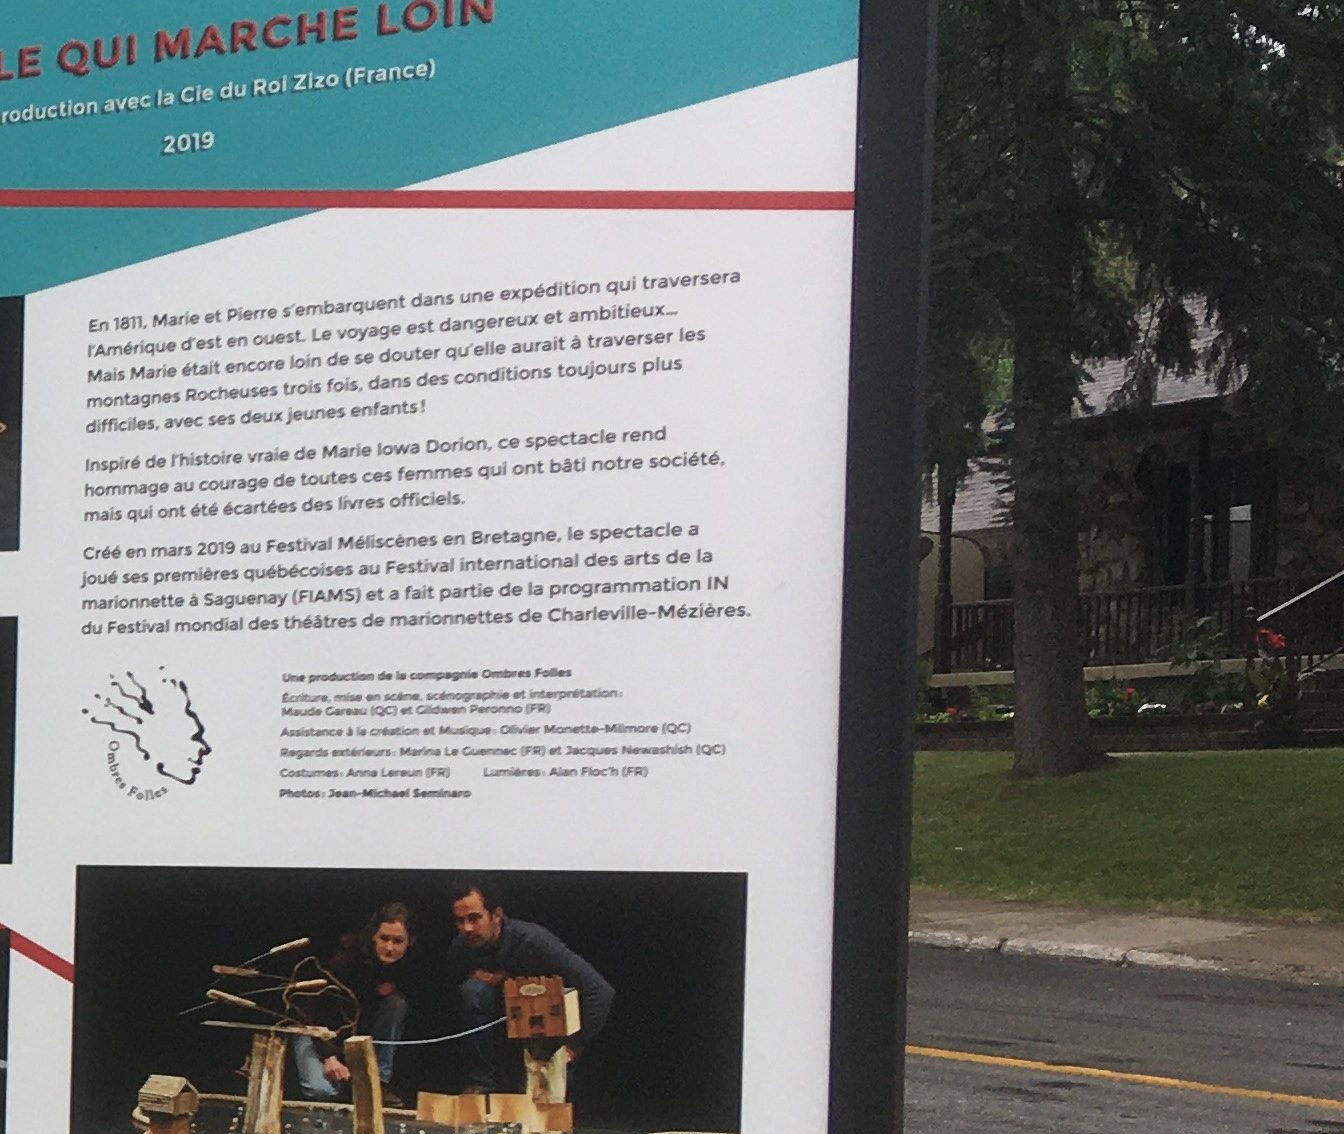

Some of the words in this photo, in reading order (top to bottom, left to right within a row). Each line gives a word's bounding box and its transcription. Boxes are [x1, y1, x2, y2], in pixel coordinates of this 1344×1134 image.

[58, 36, 138, 76] QUI
[156, 6, 358, 60] MARCHE
[379, 0, 494, 34] LOIN
[103, 94, 152, 112] avec
[157, 88, 175, 106] la
[180, 84, 215, 103] Cie
[220, 80, 248, 99] du
[253, 74, 288, 96] Roi
[293, 71, 340, 91] Zizo
[345, 58, 436, 88] (France)
[163, 130, 216, 154] 2019
[88, 318, 110, 333] En
[113, 315, 148, 331] 1811,
[152, 310, 200, 328] Marie
[204, 309, 223, 324] et
[226, 306, 278, 322] Pierre
[282, 294, 406, 318] s'embarquent
[410, 292, 455, 308] dans
[460, 290, 495, 304] une
[499, 280, 600, 303] expédition
[606, 276, 636, 296] qui
[642, 272, 741, 290] traversera
[88, 340, 177, 359] l'Amérique
[180, 335, 222, 351] d'est
[226, 336, 248, 348] en
[252, 330, 307, 346] ouest.
[312, 328, 332, 342] Le
[336, 324, 402, 342] voyage
[406, 319, 435, 335] est
[438, 314, 539, 334] dangereux
[543, 310, 564, 325] et
[86, 392, 181, 408] montagnes
[185, 385, 278, 402] Rocheuses
[283, 380, 322, 396] trois
[326, 377, 363, 393] fois,
[368, 375, 412, 390] dans
[416, 372, 449, 387] des
[453, 366, 552, 384] conditions
[557, 360, 636, 380] toujours
[642, 356, 682, 376] plus
[85, 416, 160, 434] difficiles,
[163, 416, 204, 429] avec
[207, 414, 236, 427] ses
[240, 409, 284, 425] deux
[284, 406, 346, 426] jeunes
[85, 456, 141, 474] Inspiré
[145, 454, 166, 469] de
[170, 450, 244, 468] l'histoire
[247, 447, 290, 463] vraie
[294, 446, 317, 460] de
[322, 443, 372, 460] Marie
[377, 442, 420, 456] Iowa
[424, 436, 492, 454] Dorion,
[497, 438, 521, 450] ce
[524, 429, 616, 451] spectacle
[622, 425, 668, 443] rend
[84, 506, 123, 522] mais
[126, 504, 153, 523] qui
[157, 504, 187, 519] ont
[190, 502, 218, 518] été
[222, 499, 298, 516] écartées
[301, 497, 333, 512] des
[338, 495, 385, 510] livres
[389, 491, 466, 508] officiels.
[83, 544, 122, 560] Créé
[126, 547, 147, 559] en
[151, 546, 192, 558] mars
[197, 540, 236, 556] 2019
[240, 542, 261, 554] au
[266, 536, 333, 553] Festival
[337, 534, 438, 551] Méliscènes
[442, 534, 466, 546] en
[471, 530, 562, 547] Bretagne,
[567, 526, 584, 541] le
[588, 522, 683, 544] spectacle
[688, 524, 700, 536] a
[80, 570, 118, 589] joué
[122, 572, 149, 584] ses
[153, 566, 239, 586] premières
[243, 562, 354, 583] québécoises
[358, 564, 380, 576] au
[386, 558, 455, 575] Festival
[459, 553, 580, 572] international
[584, 552, 618, 568] des
[623, 551, 660, 567] arts
[666, 549, 691, 564] de
[696, 548, 713, 563] la
[82, 594, 185, 610] marionnette
[188, 592, 199, 607] à
[203, 593, 288, 609] Saguenay
[292, 586, 362, 606] (FIAMS)
[366, 587, 384, 601] et
[388, 590, 400, 600] a
[404, 584, 435, 600] fait
[439, 583, 494, 602] partie
[498, 582, 523, 597] de
[528, 581, 544, 596] la
[548, 576, 701, 599] programmation
[707, 576, 729, 591] IN
[81, 621, 103, 635] du
[107, 618, 170, 634] Festival
[174, 616, 244, 632] mondial
[248, 616, 282, 631] des
[284, 614, 358, 632] théâtres
[360, 612, 386, 628] de
[389, 610, 514, 627] marionnettes
[517, 608, 543, 624] de
[547, 602, 751, 622] Charleville-Mézières.
[281, 673, 307, 683] Une
[308, 671, 375, 684] production
[376, 670, 394, 681] de
[395, 670, 407, 681] la
[409, 668, 479, 682] compagnie
[480, 668, 532, 679] Ombres
[534, 667, 572, 678] Folles
[281, 706, 323, 717] Maude
[370, 705, 398, 717] (QC)
[400, 706, 414, 716] et
[108, 740, 126, 790] Ombres
[128, 786, 168, 801] Folles
